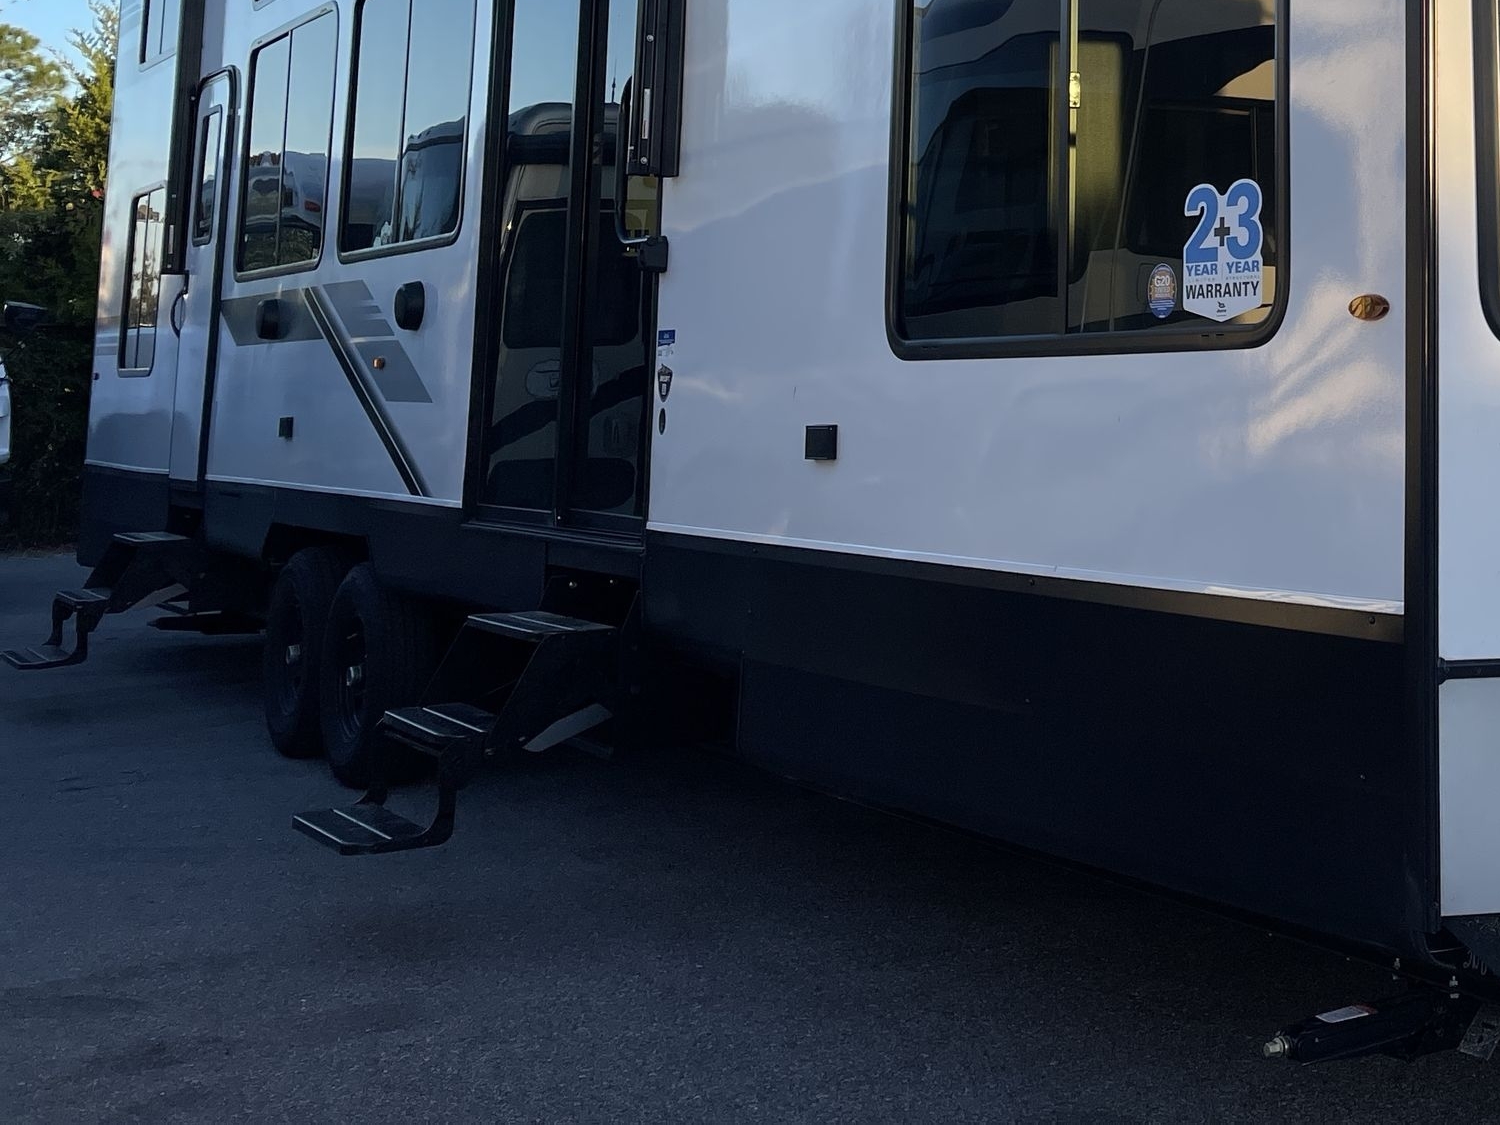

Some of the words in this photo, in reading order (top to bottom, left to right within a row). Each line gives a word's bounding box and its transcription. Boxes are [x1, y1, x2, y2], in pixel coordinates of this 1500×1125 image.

[1186, 264, 1218, 276] YEAR
[1226, 260, 1259, 273] YEAR
[1185, 281, 1260, 299] WARRANTY
